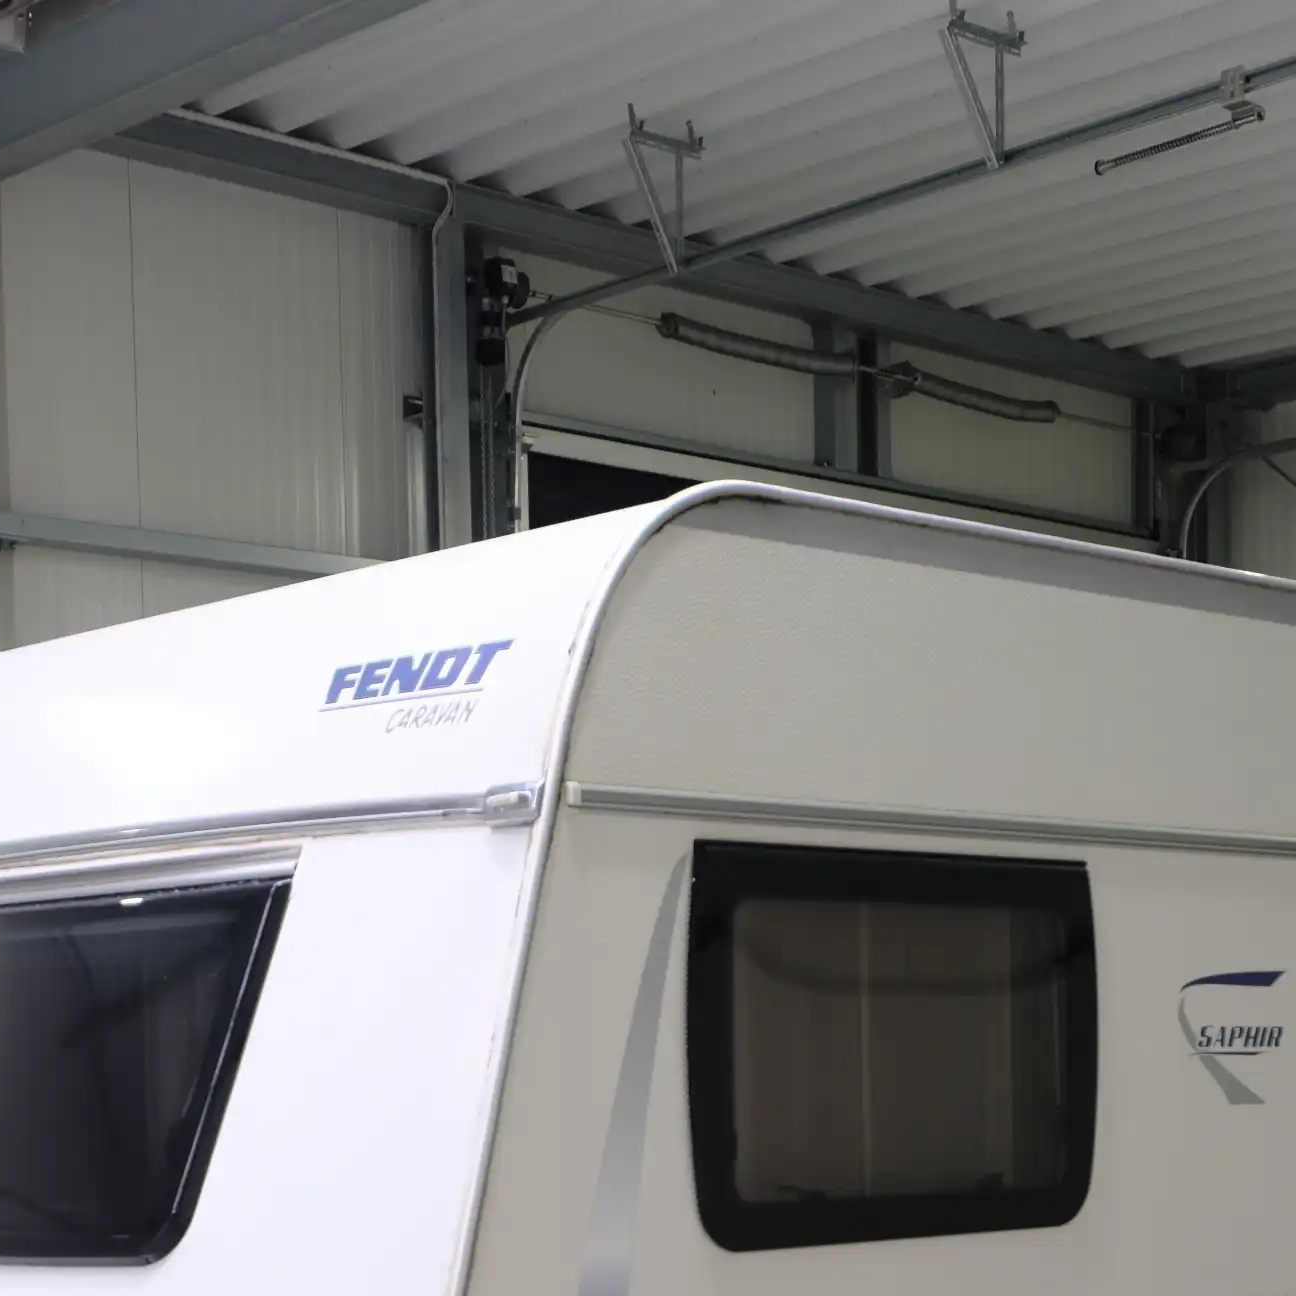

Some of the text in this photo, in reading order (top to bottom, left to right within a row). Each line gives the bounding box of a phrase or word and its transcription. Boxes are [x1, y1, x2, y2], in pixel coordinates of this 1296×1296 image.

[324, 639, 515, 705] FENDT
[385, 700, 480, 734] CARAVAN
[1198, 1025, 1284, 1048] SAPHIR
